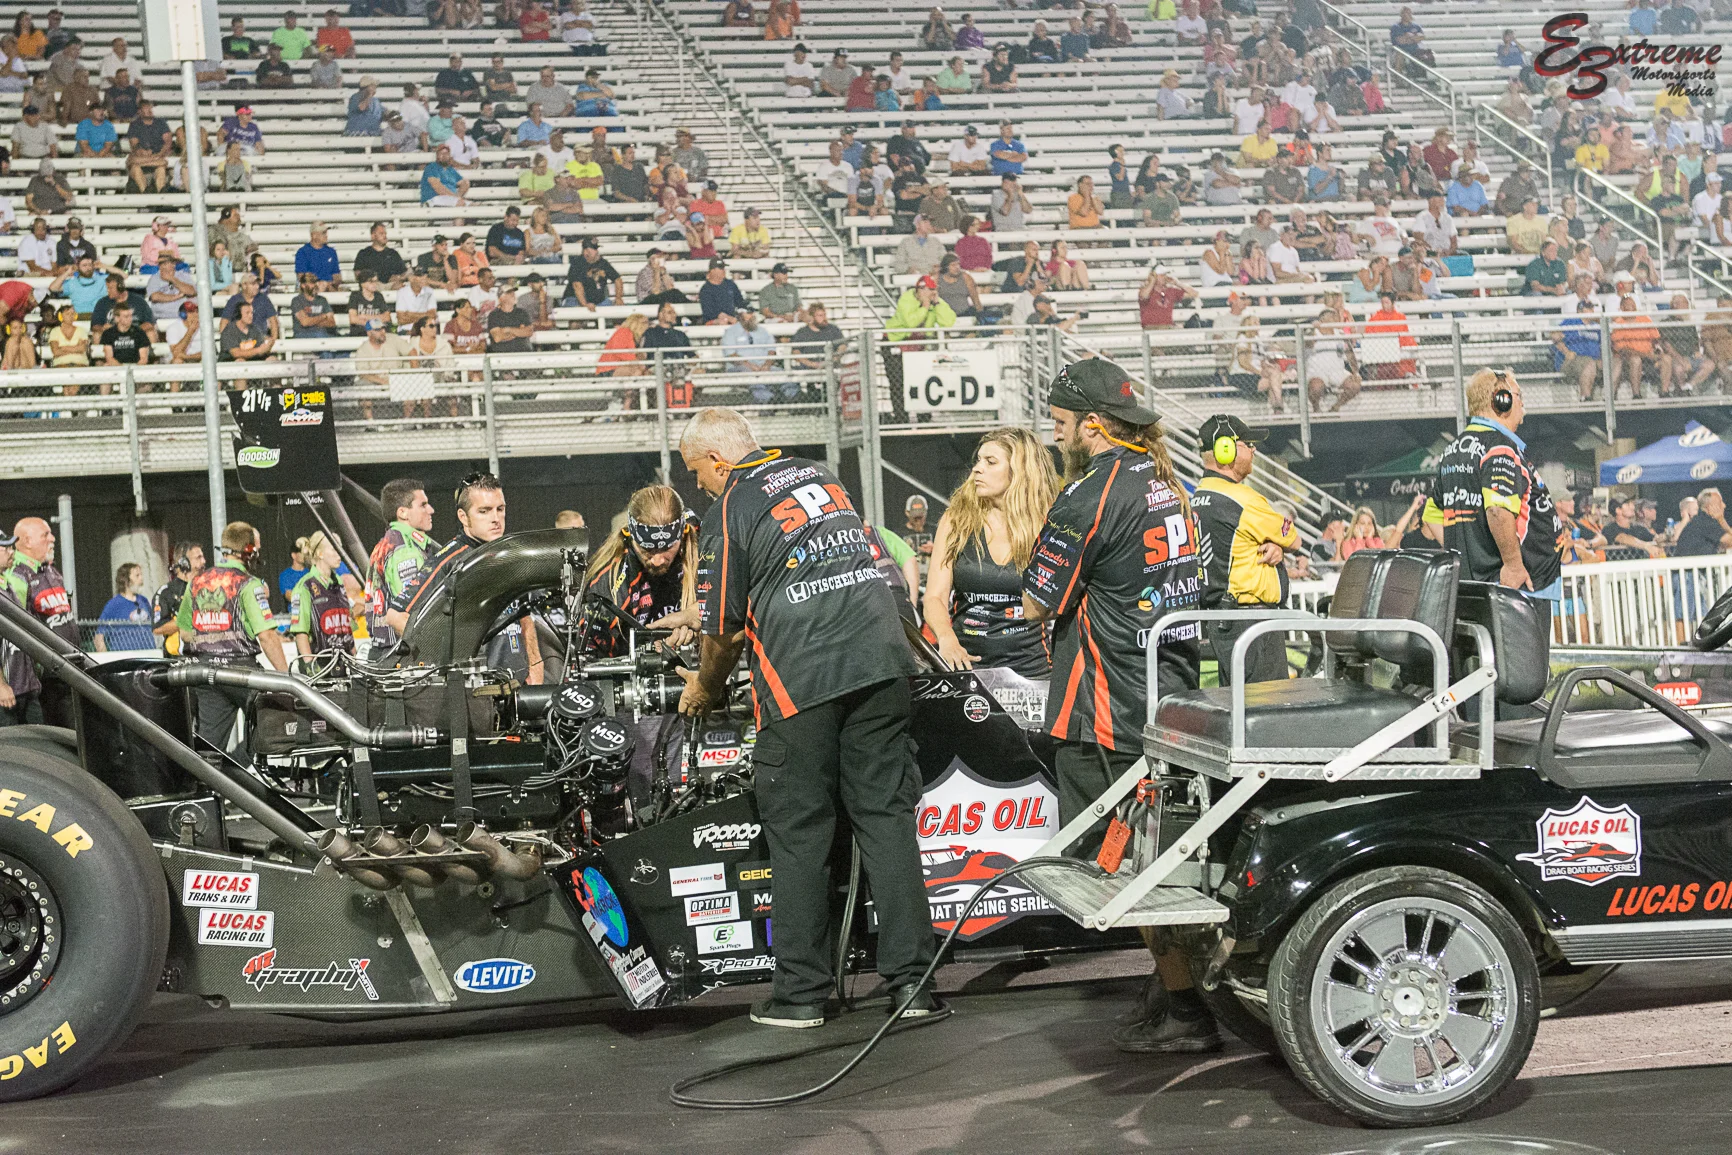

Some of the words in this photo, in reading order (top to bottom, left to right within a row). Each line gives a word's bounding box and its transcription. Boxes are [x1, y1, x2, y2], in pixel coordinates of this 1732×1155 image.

[761, 466, 817, 494] THOMPSON
[810, 511, 841, 526] PALMER
[1143, 561, 1167, 574] SCOTT
[809, 571, 856, 595] FISCHER
[976, 594, 1010, 603] FISCHER
[561, 687, 594, 709] MSD
[590, 724, 625, 745] MSD
[702, 749, 738, 761] MSD
[992, 795, 1047, 831] OIL
[693, 823, 761, 849] VOODOO
[1547, 819, 1600, 837] LUCAS
[1604, 818, 1630, 833] OIL
[1546, 866, 1567, 876] DRAG
[1567, 865, 1587, 875] BOAT
[1587, 864, 1611, 874] RACING
[1611, 863, 1636, 872] SERIES
[191, 874, 252, 893] LUCAS
[672, 877, 699, 885] GENERAL
[188, 891, 220, 903] TRANS
[220, 895, 228, 903] &
[230, 894, 252, 904] DIFF
[691, 897, 731, 911] OPTIMA
[1606, 882, 1700, 917] LUCAS
[207, 912, 267, 931] LUCAS
[206, 930, 248, 941] RACING
[248, 932, 266, 942] OIL
[454, 961, 535, 989] CLEVITE
[634, 962, 650, 976] MOTION
[640, 966, 659, 986] INDUSTRIES
